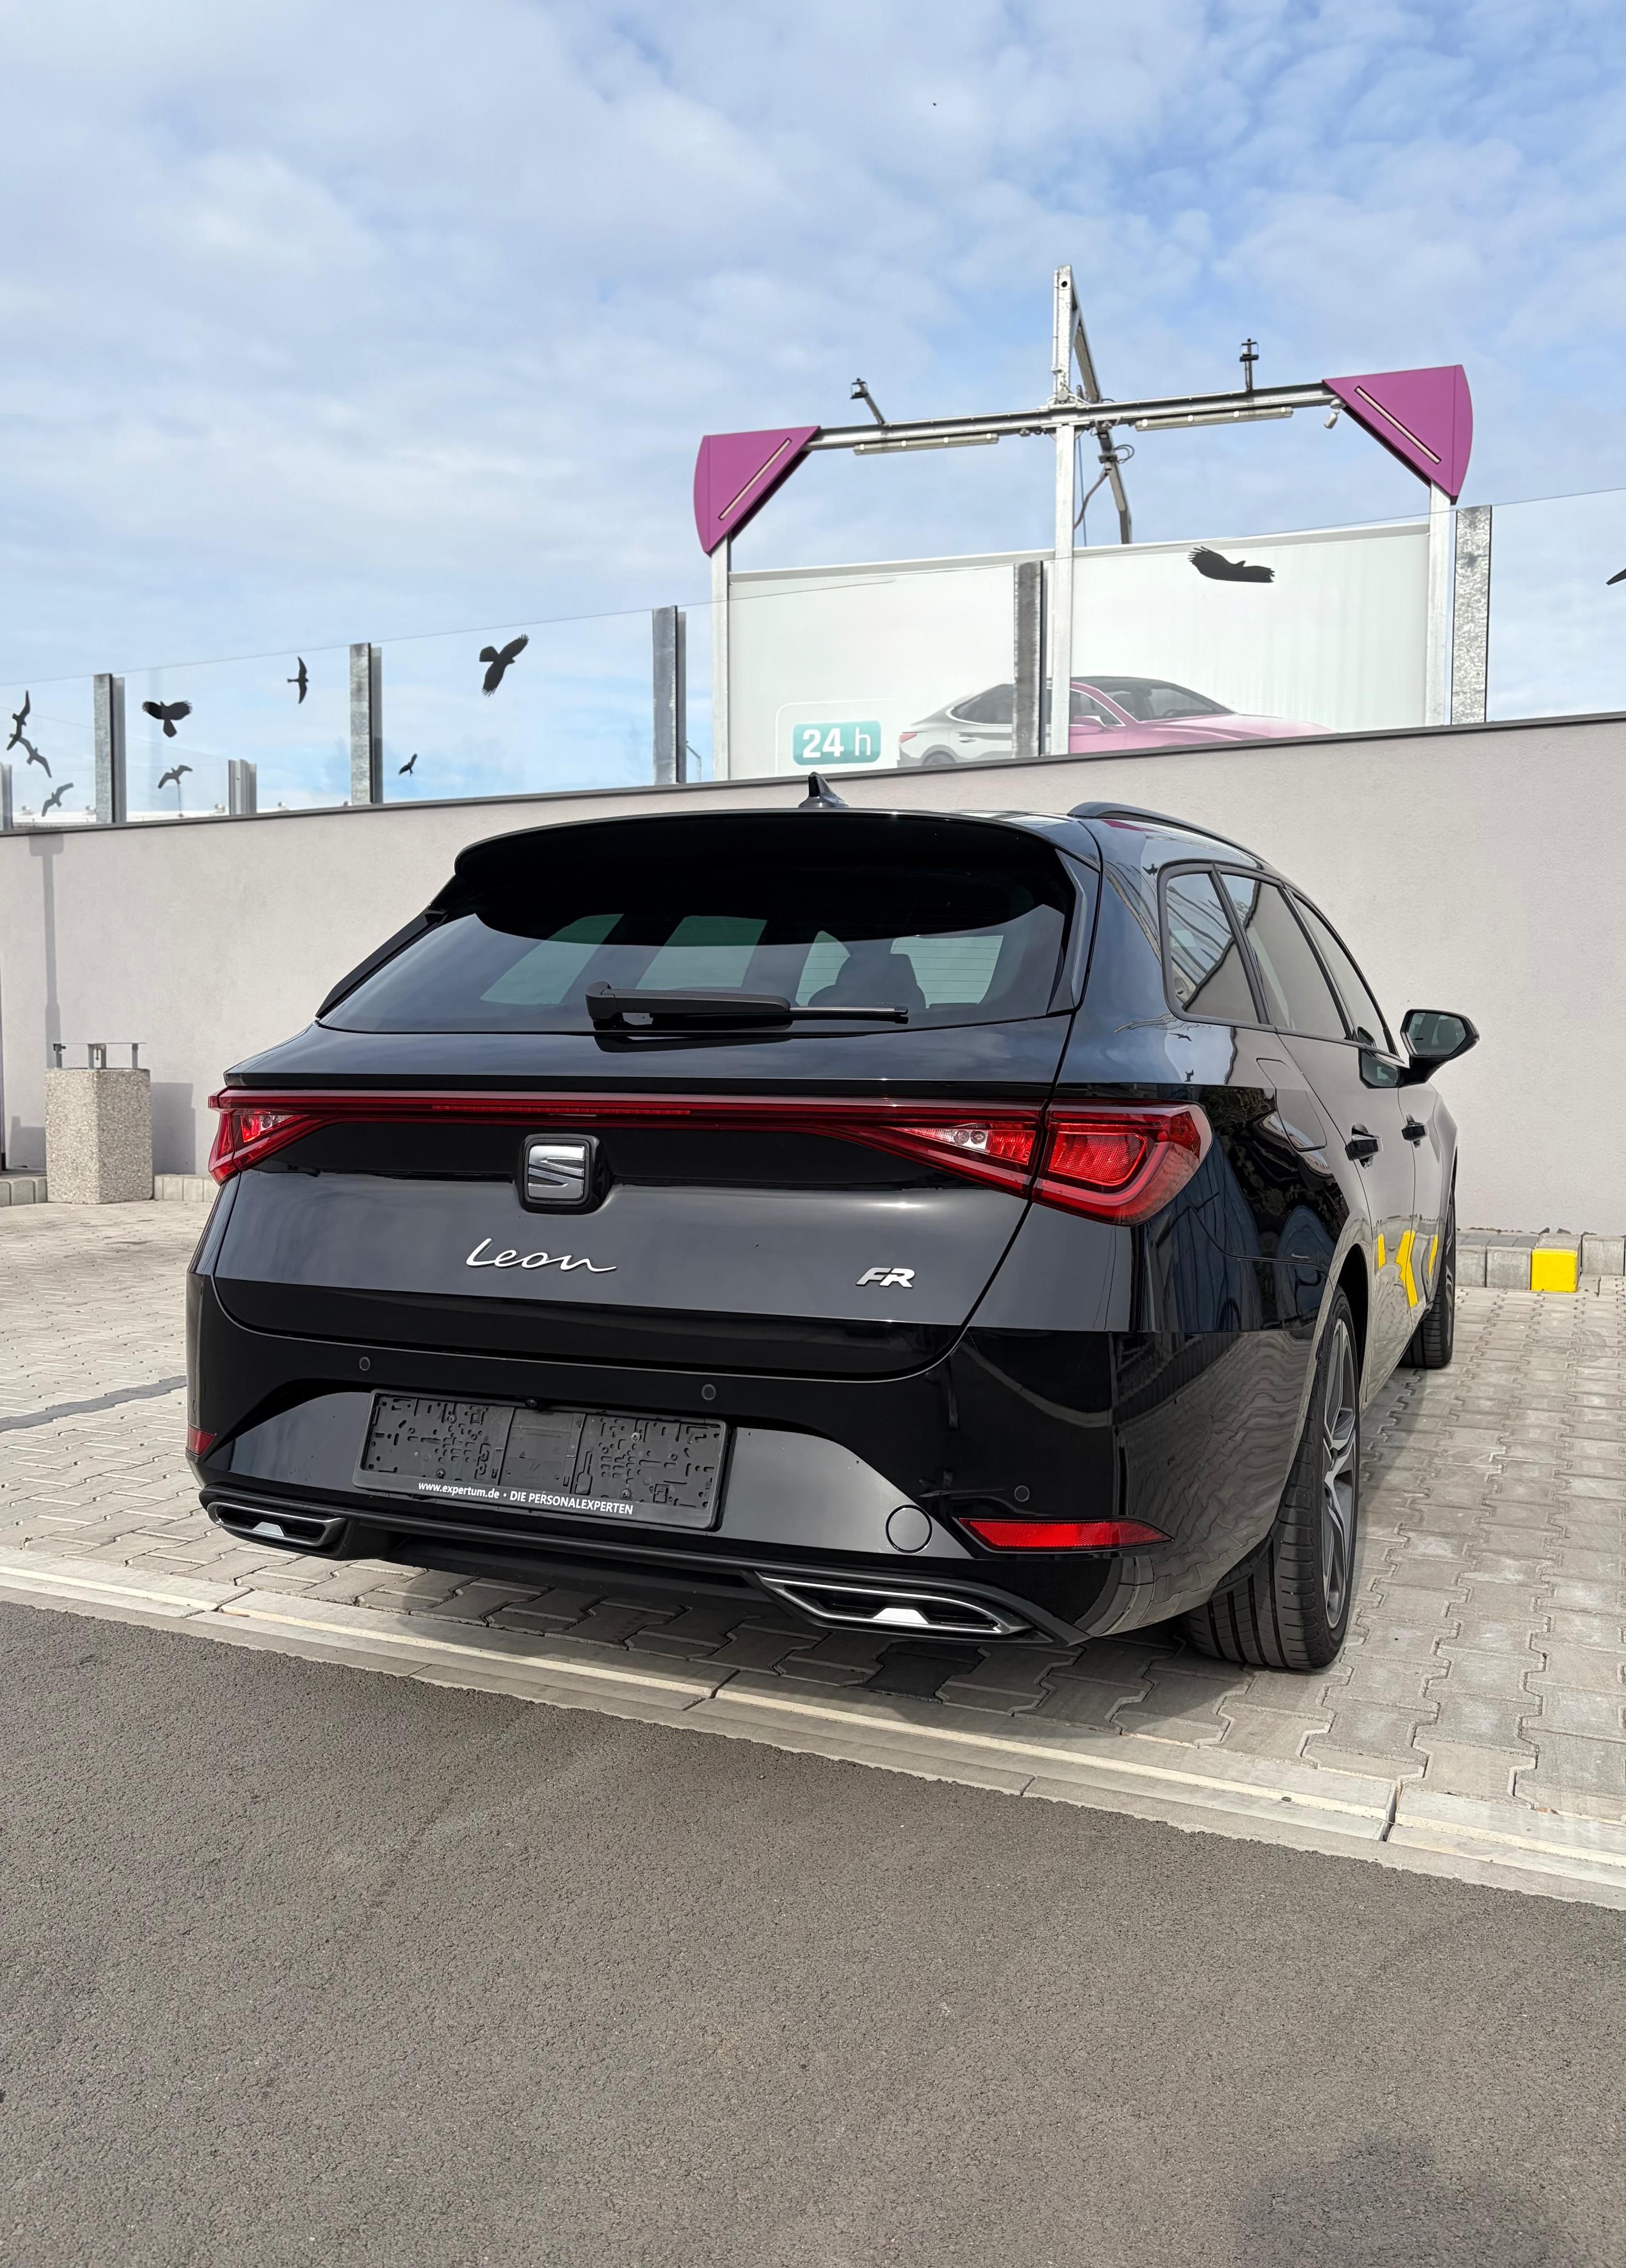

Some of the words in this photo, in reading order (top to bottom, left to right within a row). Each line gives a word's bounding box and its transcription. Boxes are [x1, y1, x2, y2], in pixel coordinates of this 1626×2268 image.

[803, 728, 844, 758] 24
[854, 726, 871, 756] h
[466, 1238, 616, 1273] Leon
[856, 1267, 915, 1288] FR
[419, 1482, 499, 1498] www.expertum.de
[509, 1491, 526, 1502] DIE
[528, 1493, 633, 1515] PERSONALEXPERTEN
